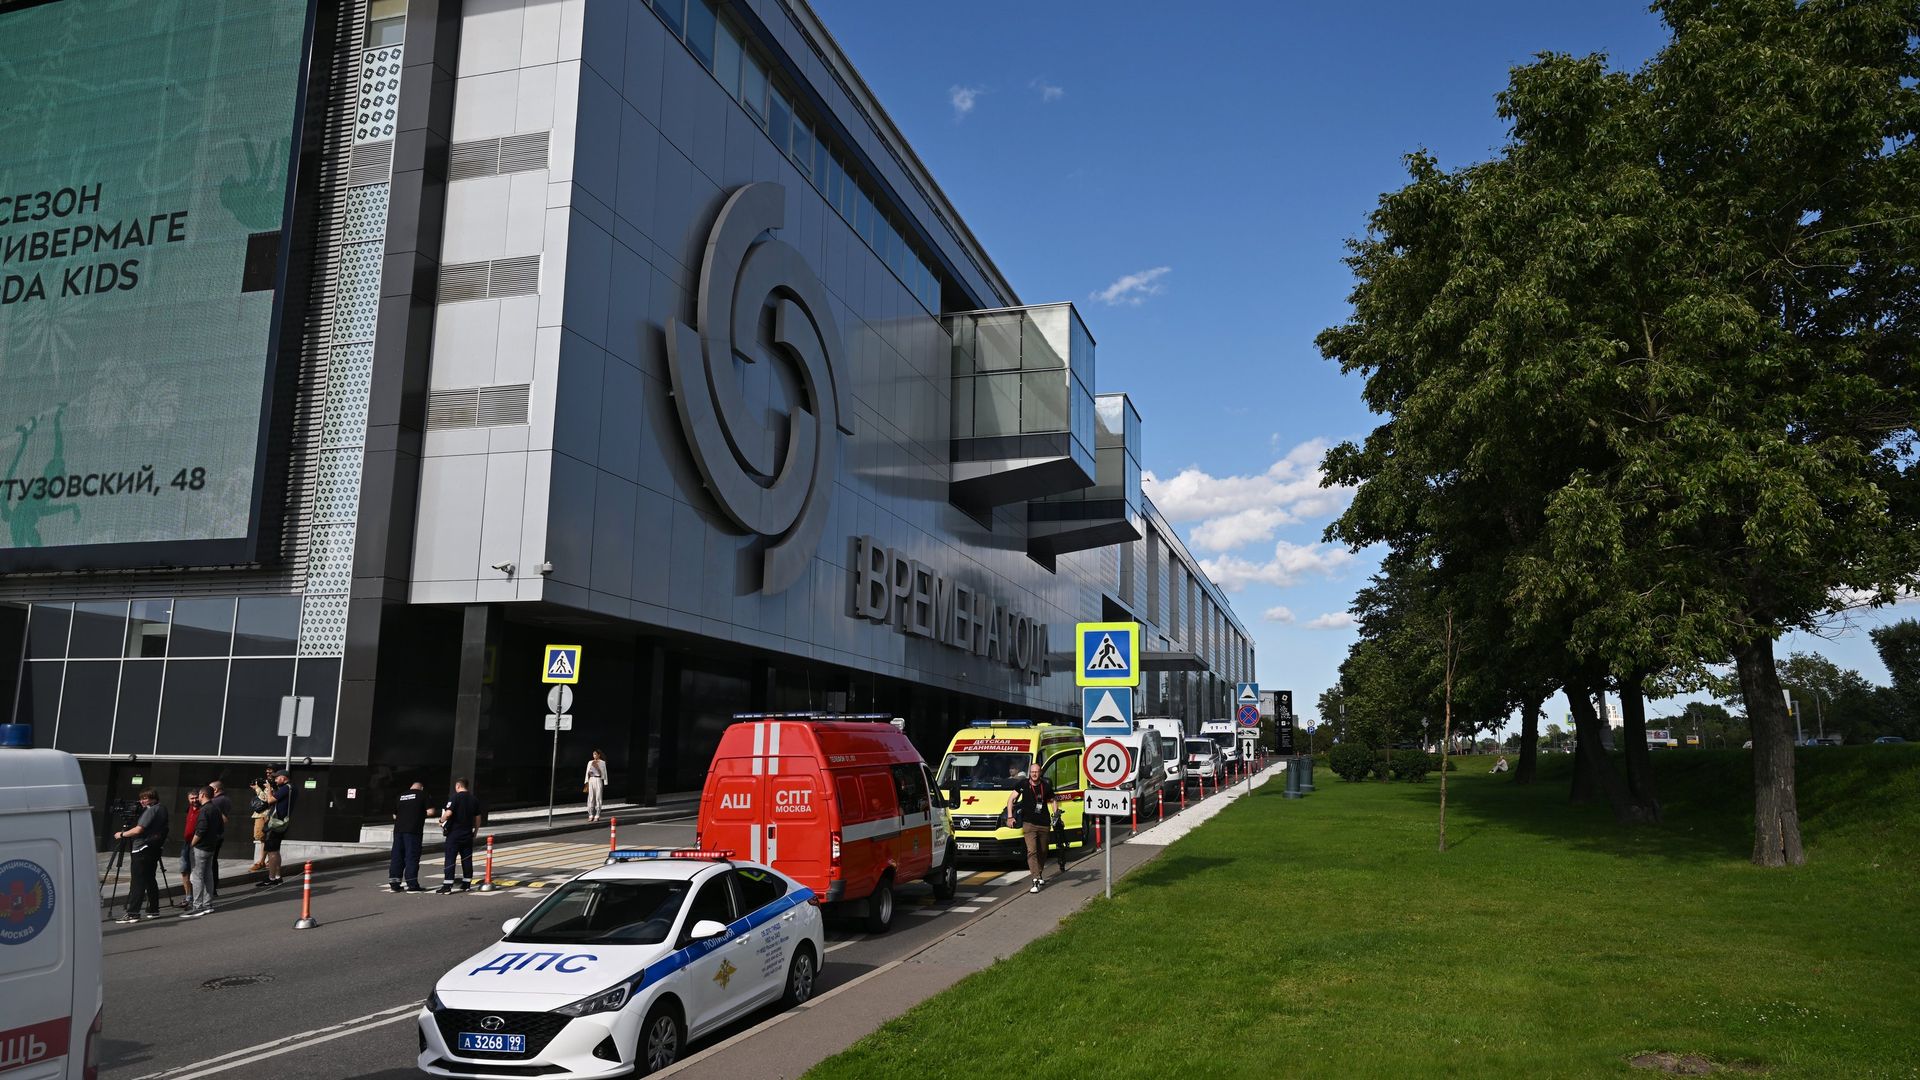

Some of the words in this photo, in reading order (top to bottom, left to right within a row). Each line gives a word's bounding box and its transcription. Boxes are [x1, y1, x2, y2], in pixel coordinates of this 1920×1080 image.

[0, 183, 102, 226] СЕЗОН
[0, 210, 188, 265] ИВЕРМАГЕ
[0, 272, 46, 305] DA
[61, 259, 140, 298] KIDS
[170, 466, 207, 492] 48
[1093, 753, 1120, 773] 20
[720, 793, 751, 809] АШ
[775, 789, 812, 805] СПТ
[1097, 798, 1110, 809] 30
[775, 805, 812, 813] МОСКВА
[0, 925, 34, 939] МОСКВА
[702, 928, 735, 951] ПОЛИЦИЯ
[468, 952, 598, 976] ДПС
[475, 1035, 503, 1049] 3268
[509, 1036, 521, 1047] 99
